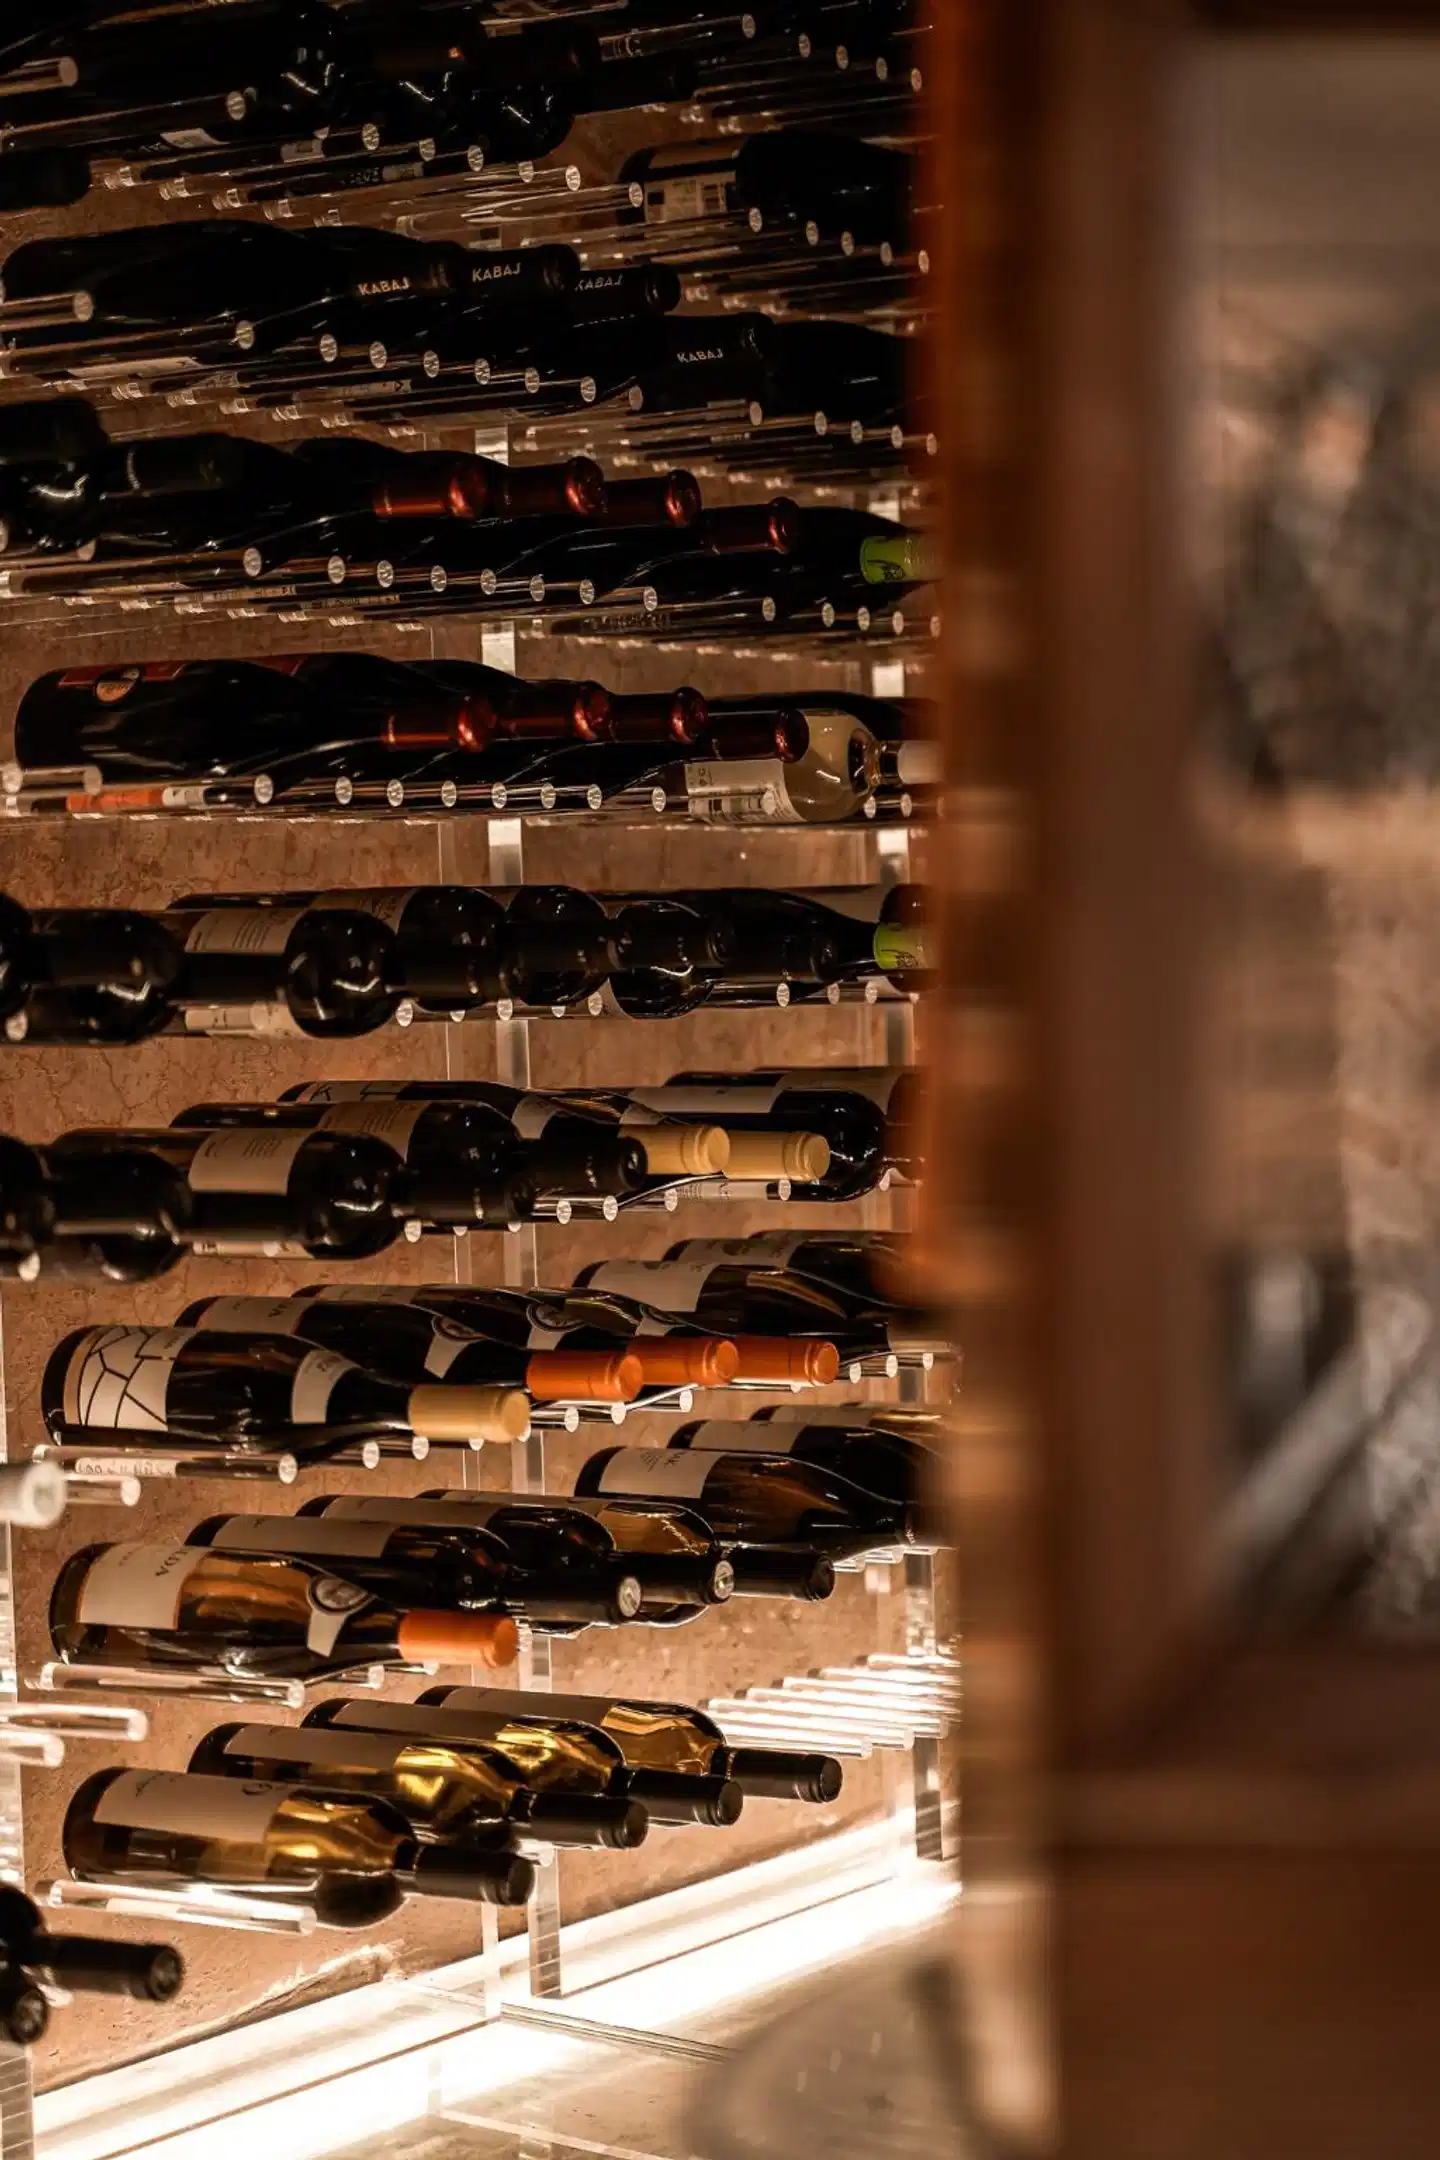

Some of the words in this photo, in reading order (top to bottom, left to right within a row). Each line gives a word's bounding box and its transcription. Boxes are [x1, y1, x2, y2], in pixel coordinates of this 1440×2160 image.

[472, 262, 521, 282] KABAJ
[357, 276, 410, 296] KABAJ
[574, 273, 623, 292] KABAJ
[676, 347, 724, 363] KABAJ
